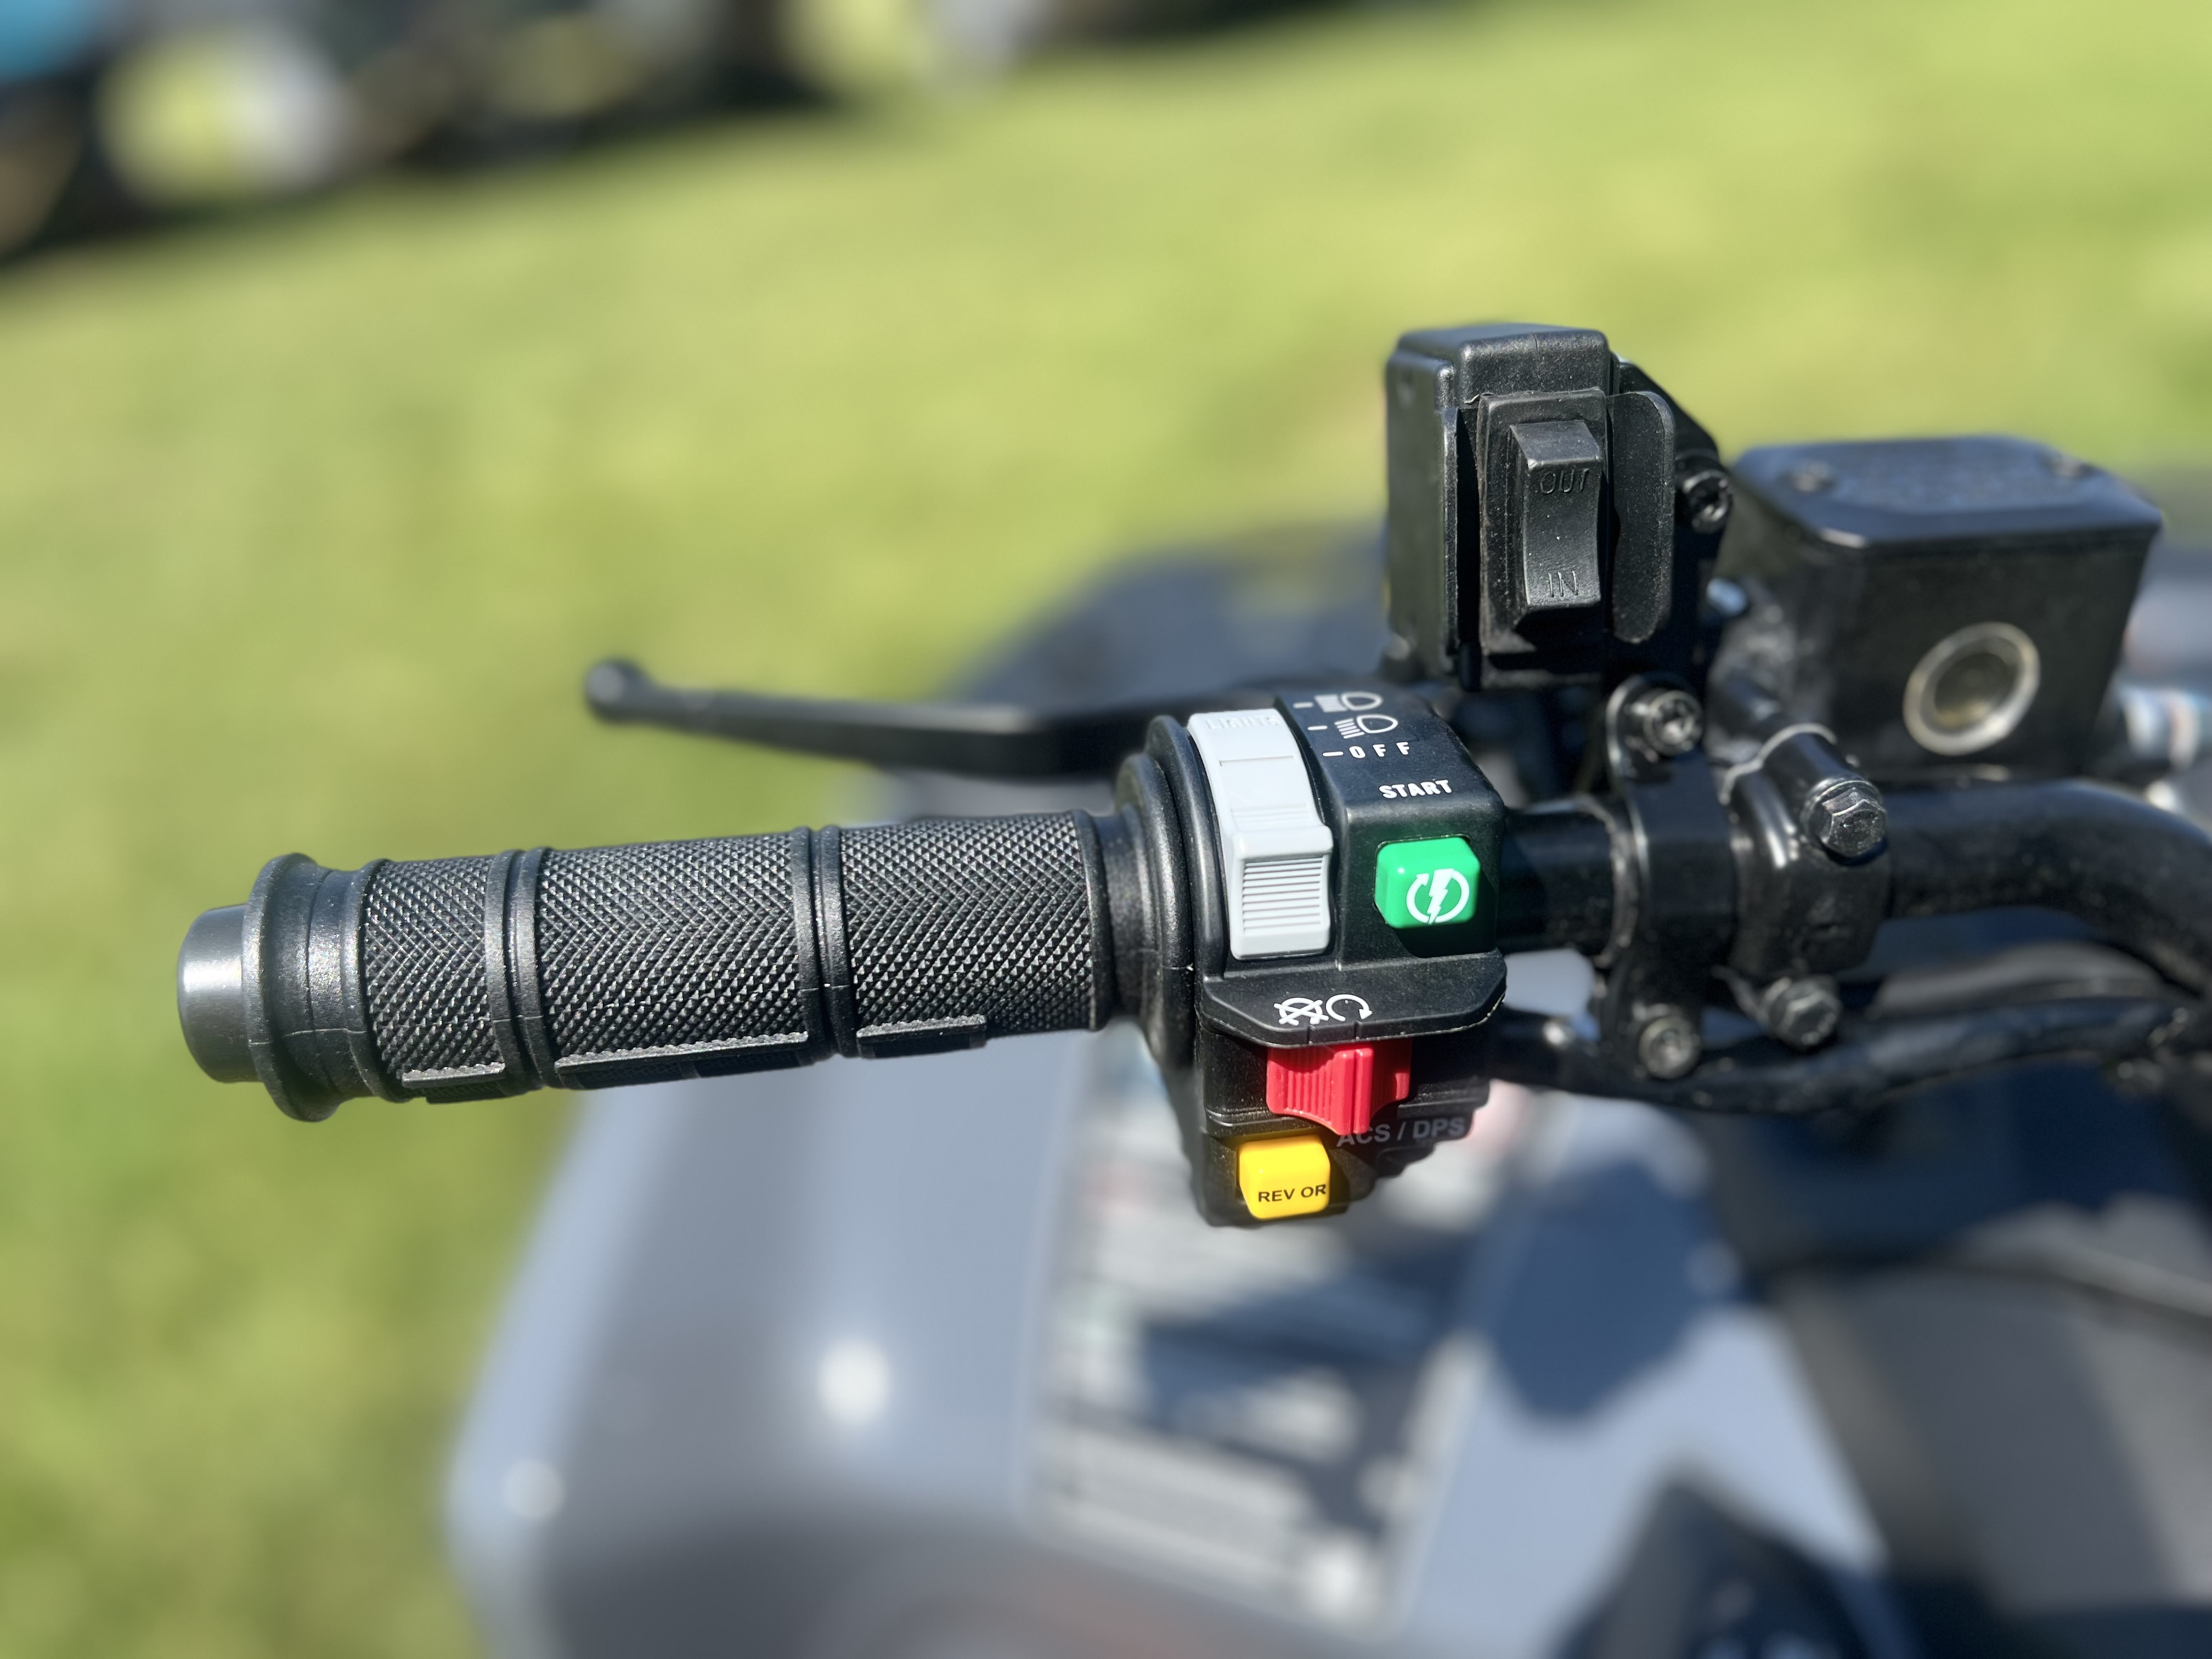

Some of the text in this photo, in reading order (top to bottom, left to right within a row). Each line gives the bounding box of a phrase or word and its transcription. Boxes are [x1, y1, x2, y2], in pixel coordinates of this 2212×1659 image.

[1539, 467, 1590, 494] OUT
[1548, 571, 1578, 598] IN
[1205, 715, 1282, 730] LIGHTS
[1349, 742, 1410, 758] OFF
[1379, 779, 1452, 799] START
[1336, 1124, 1391, 1148] ACS
[1413, 1117, 1466, 1139] DPS
[1258, 1183, 1327, 1202] REV OR
